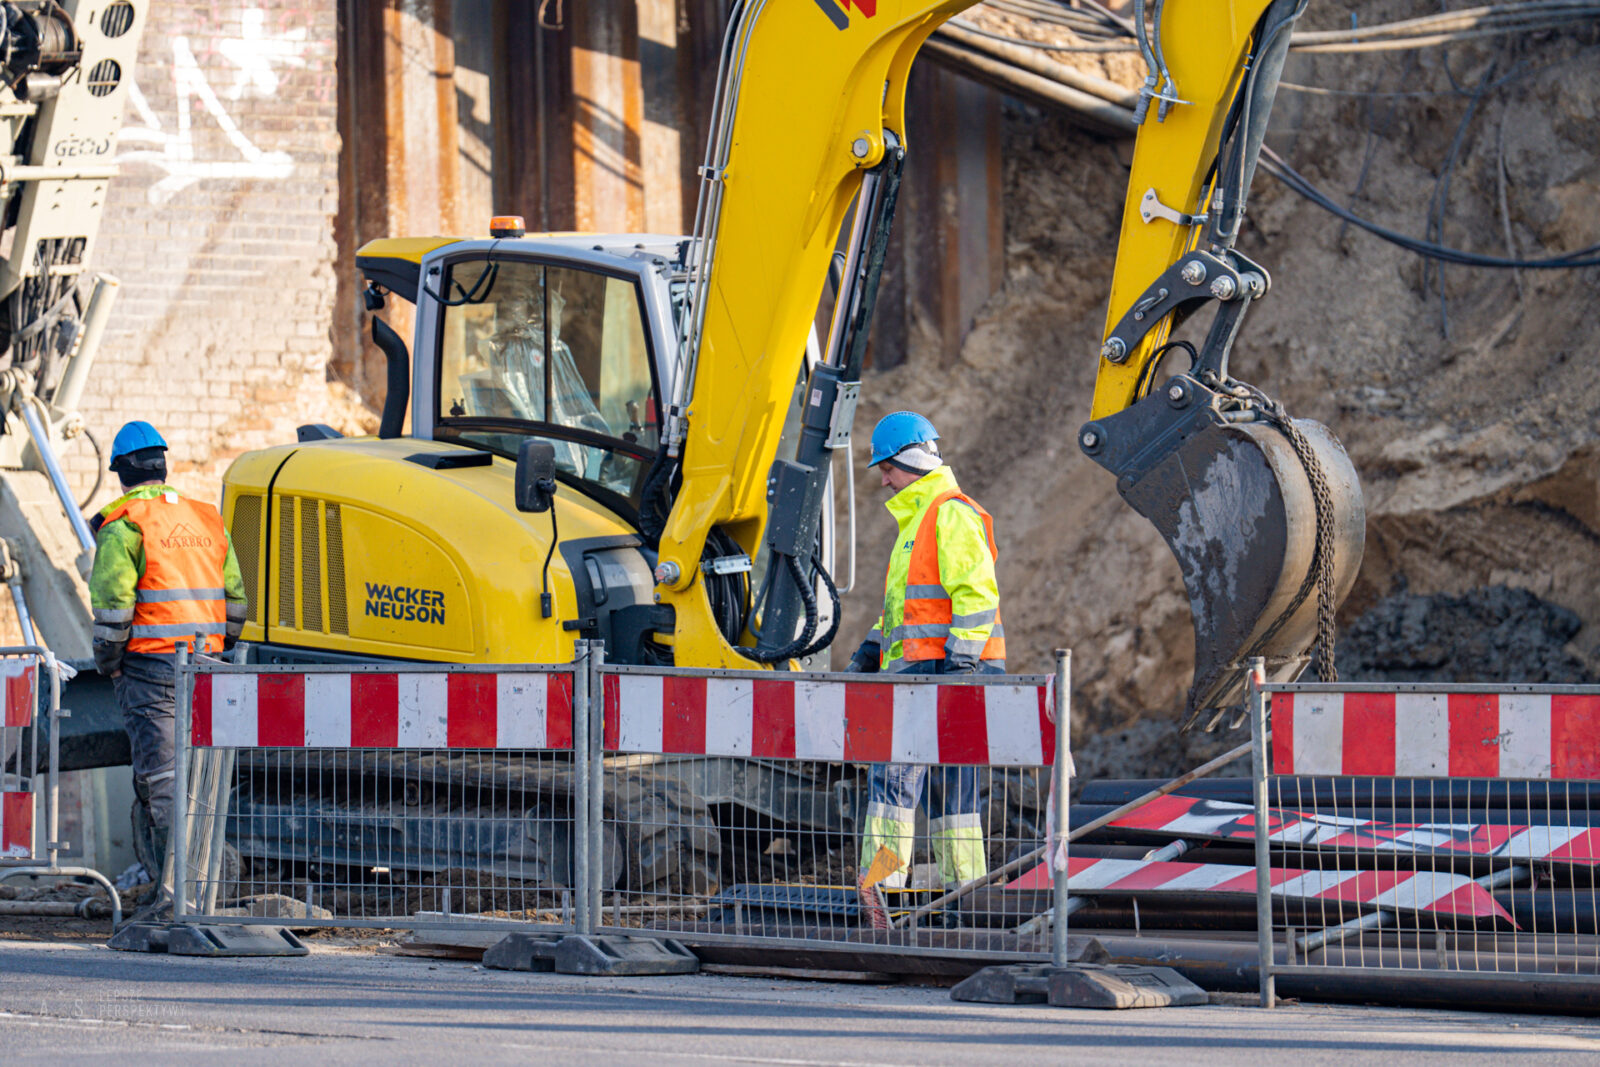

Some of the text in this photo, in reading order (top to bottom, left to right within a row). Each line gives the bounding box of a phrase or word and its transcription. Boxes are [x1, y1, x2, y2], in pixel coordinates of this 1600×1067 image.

[160, 536, 212, 549] MARBRO
[364, 582, 446, 608] WACKER
[365, 599, 446, 625] NEUSON
